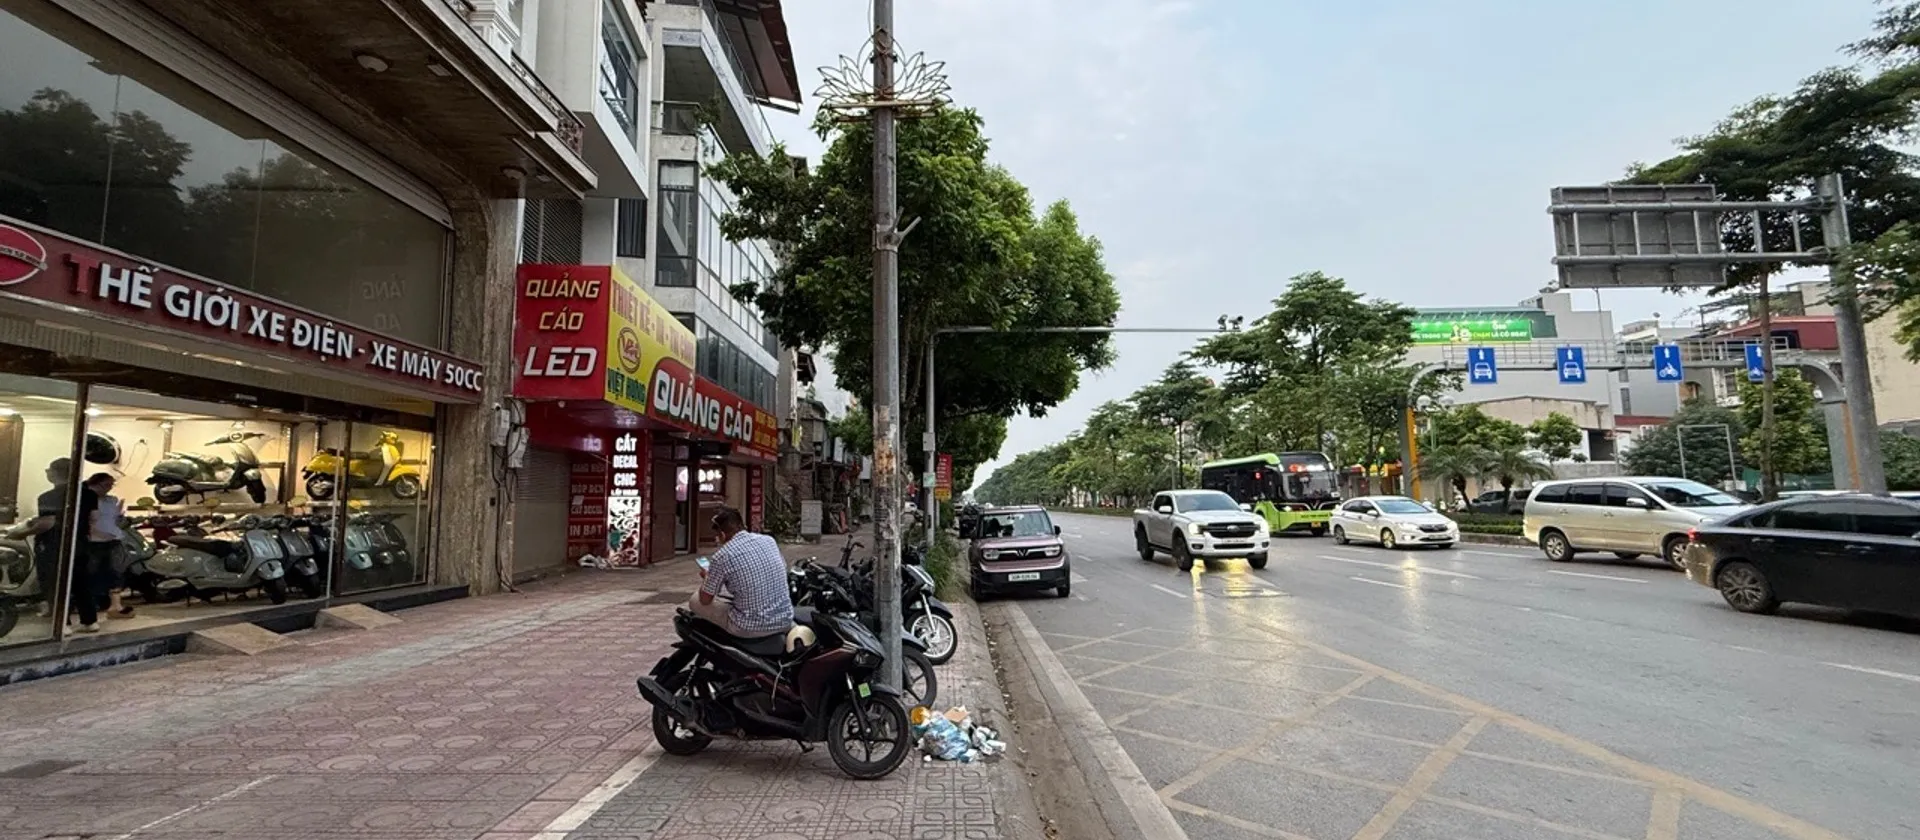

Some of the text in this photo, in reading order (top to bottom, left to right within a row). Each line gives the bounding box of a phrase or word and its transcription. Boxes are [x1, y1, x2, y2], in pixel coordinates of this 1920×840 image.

[525, 272, 601, 299] QUẢNG
[66, 253, 160, 309] THẾ
[164, 284, 240, 331] GIỚI
[249, 308, 285, 342] XE
[292, 316, 354, 361] ĐIỆN
[371, 340, 397, 369] XE
[401, 351, 442, 381] MÁY
[445, 361, 483, 392] 50CC
[539, 306, 584, 330] CÁO
[524, 346, 597, 377] LED
[654, 369, 719, 431] QUẢNG
[723, 401, 752, 442] CÁO
[613, 455, 638, 468] DECAL
[614, 473, 636, 486] CNC
